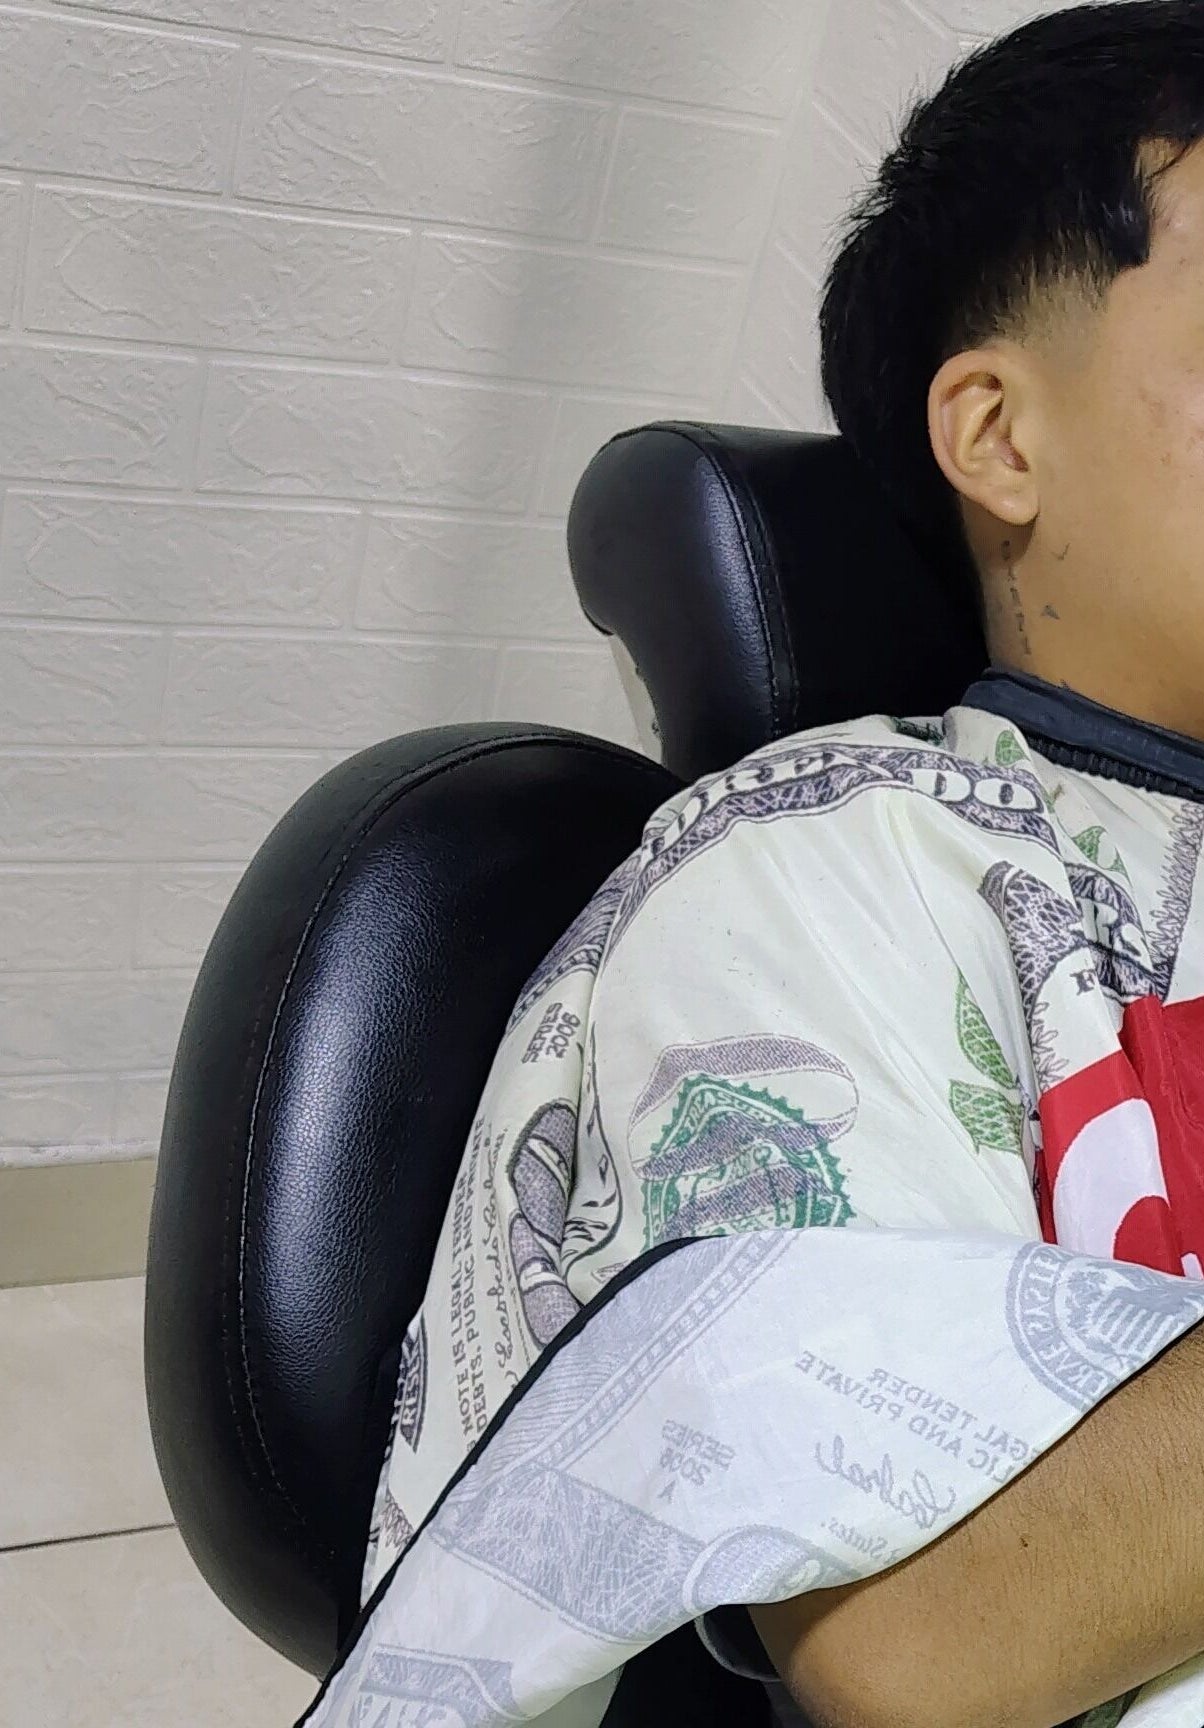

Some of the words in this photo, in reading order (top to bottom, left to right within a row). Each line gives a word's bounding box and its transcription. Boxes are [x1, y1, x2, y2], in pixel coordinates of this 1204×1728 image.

[521, 1002, 563, 1064] SERIES
[545, 1012, 581, 1059] 2006
[682, 1090, 779, 1133] TREASUR
[463, 1205, 474, 1251] AND
[451, 1261, 463, 1337] LEGAL
[463, 1253, 480, 1343] PUBLIC
[452, 1339, 467, 1367] IS
[456, 1367, 473, 1436] NOTE
